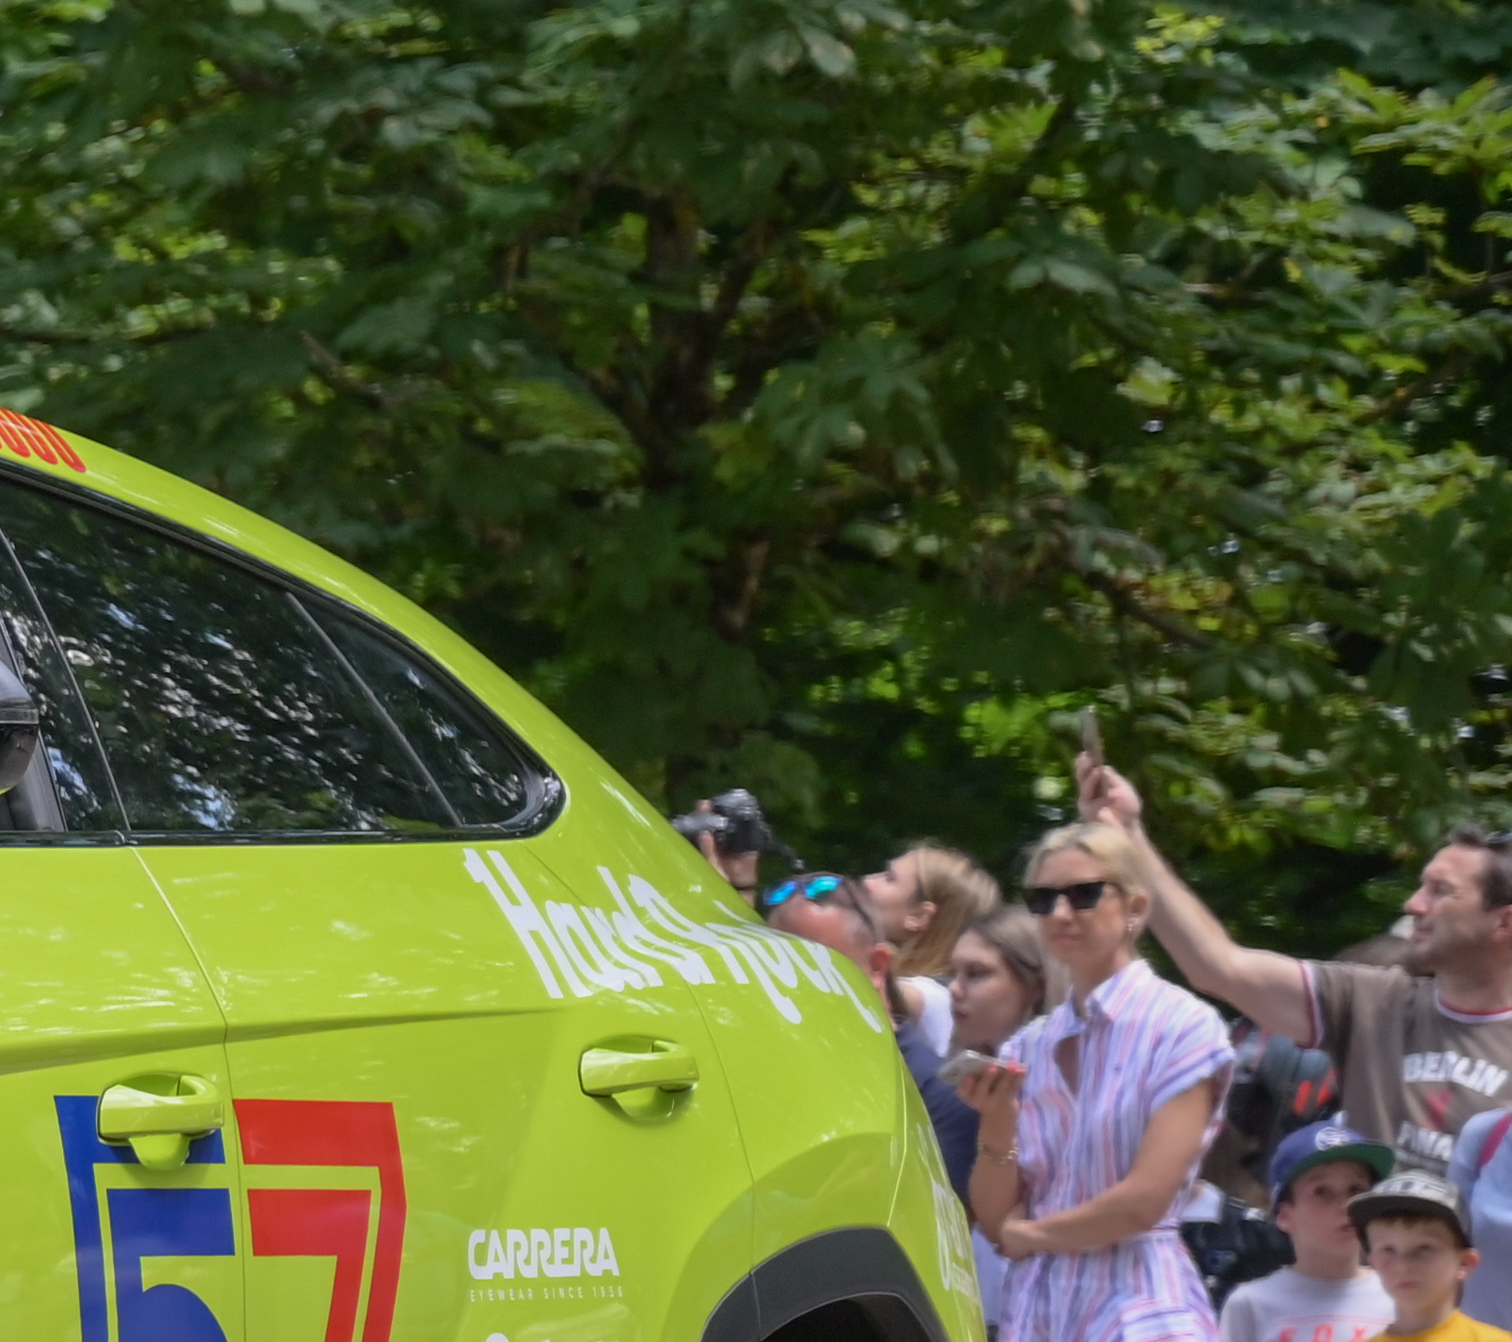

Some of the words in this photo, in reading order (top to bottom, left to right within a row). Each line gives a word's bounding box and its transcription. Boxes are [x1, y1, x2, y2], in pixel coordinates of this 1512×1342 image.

[463, 848, 715, 999] Hard
[628, 873, 883, 1034] Rock
[468, 1227, 620, 1280] CARRERA
[470, 1288, 534, 1303] EYEWEAR
[544, 1286, 584, 1300] SINCE
[592, 1285, 624, 1299] 1956
